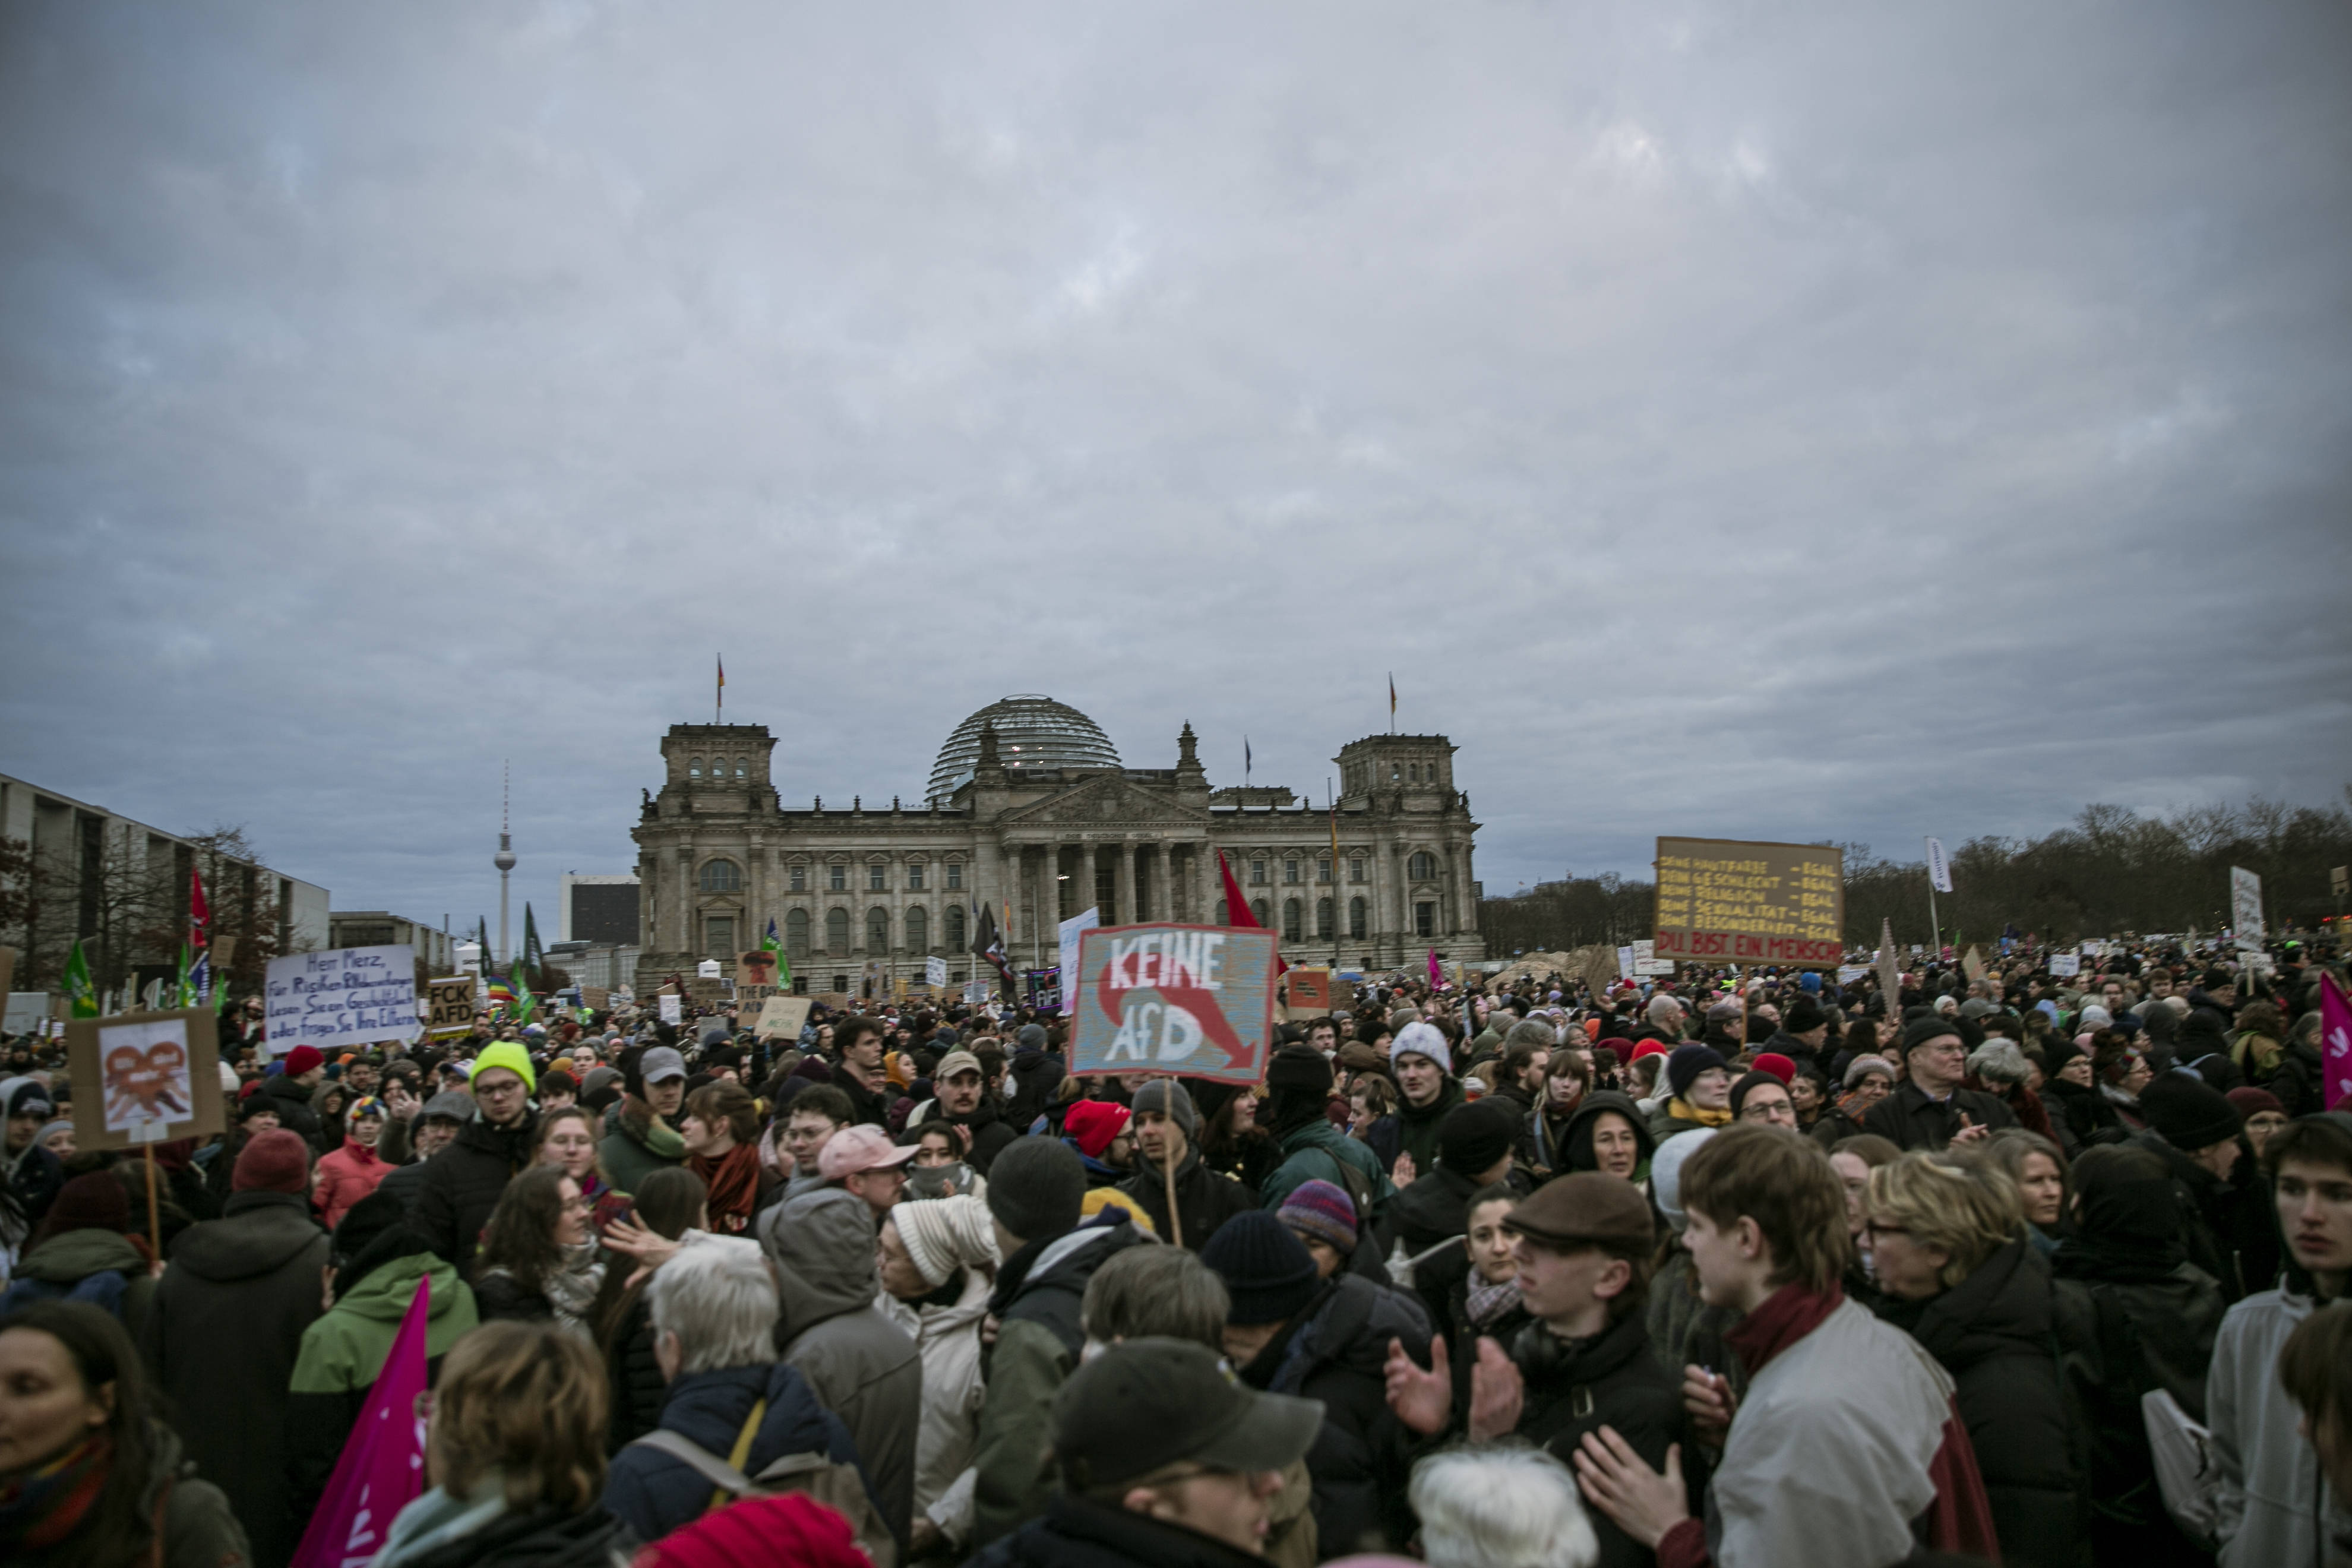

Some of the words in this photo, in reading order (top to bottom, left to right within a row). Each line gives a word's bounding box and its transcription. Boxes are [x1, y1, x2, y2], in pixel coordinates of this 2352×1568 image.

[1658, 931, 1685, 952] DU
[1735, 934, 1764, 957] EIN
[307, 952, 338, 972] Herr
[1110, 931, 1226, 990] KEINE
[431, 985, 470, 1004] FCK
[432, 1004, 472, 1024] AFD
[1104, 1002, 1203, 1061] AfD
